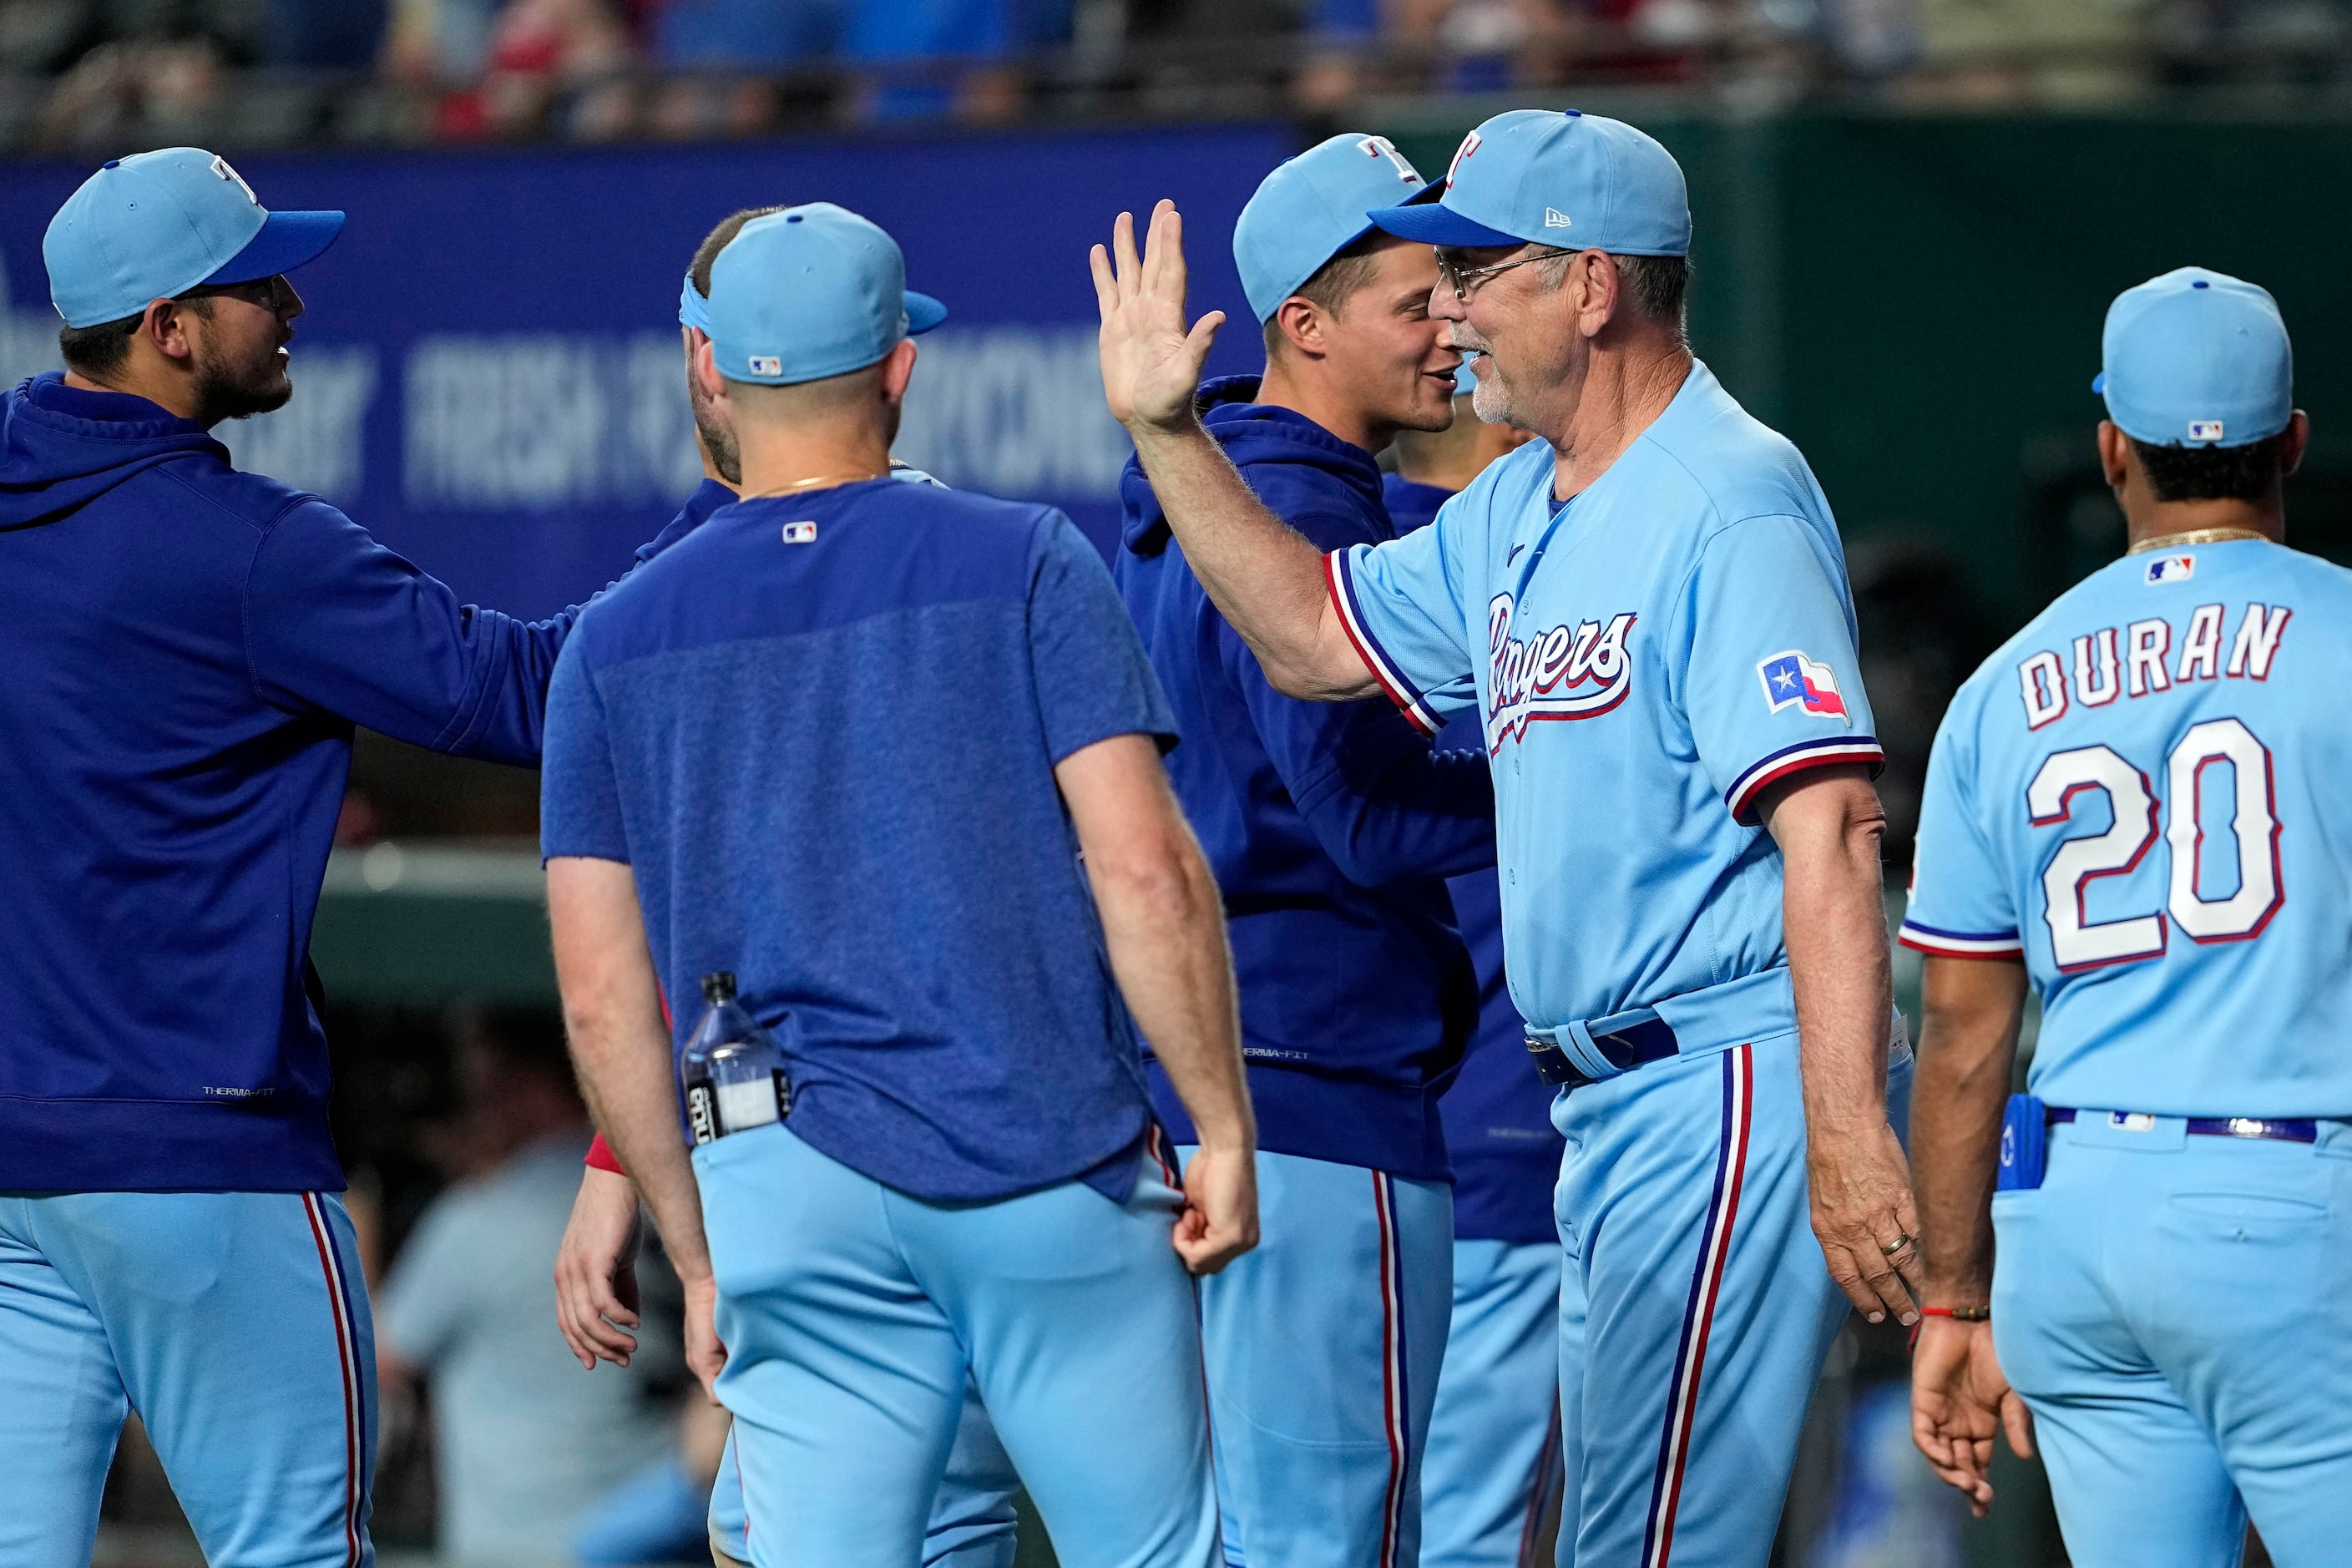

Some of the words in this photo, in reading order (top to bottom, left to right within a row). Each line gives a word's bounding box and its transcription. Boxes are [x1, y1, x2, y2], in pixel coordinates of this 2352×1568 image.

[1488, 590, 1638, 757] Rngers
[2017, 602, 2293, 731] DURAN
[2026, 716, 2286, 974] 20
[202, 1086, 276, 1097] THERMA-FIT
